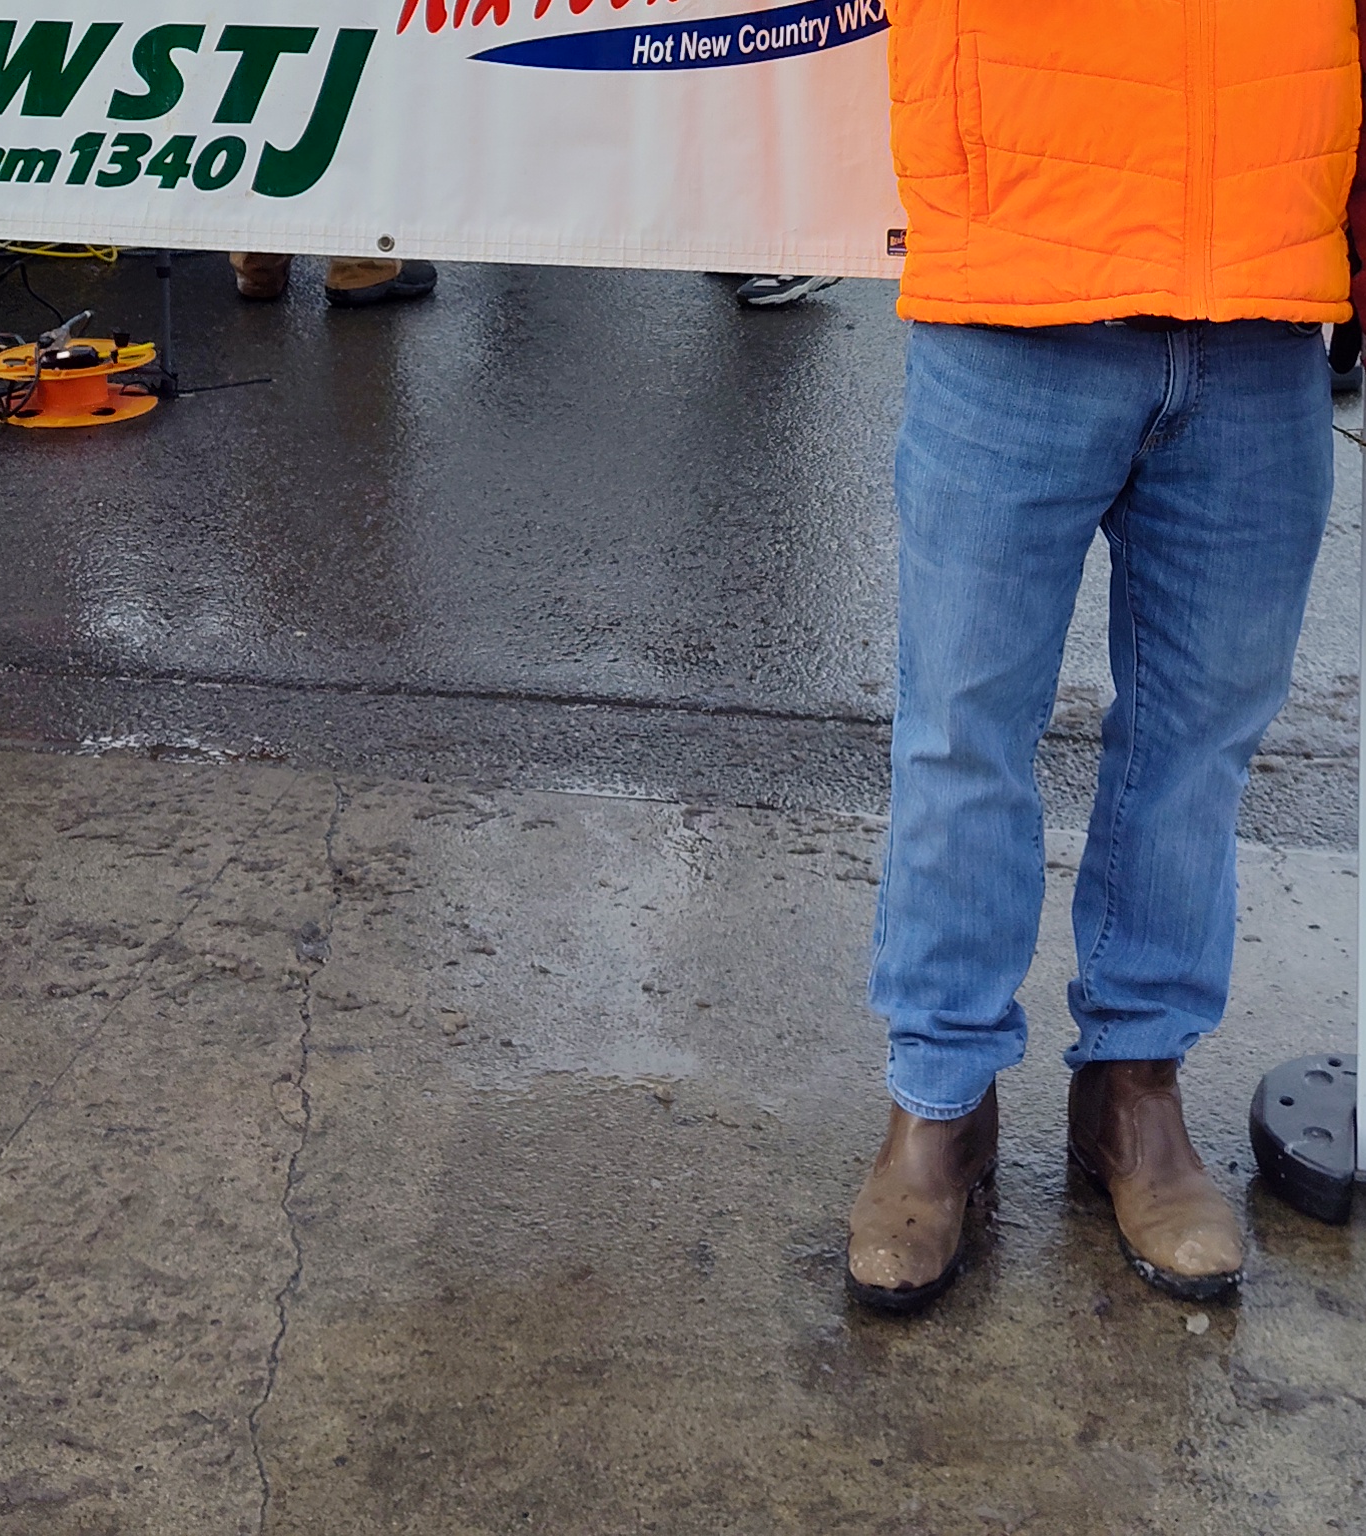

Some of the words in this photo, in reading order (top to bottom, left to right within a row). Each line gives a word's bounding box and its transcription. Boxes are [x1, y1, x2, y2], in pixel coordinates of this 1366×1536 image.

[632, 34, 674, 65] Hot
[680, 32, 731, 61] New
[738, 15, 831, 55] Country
